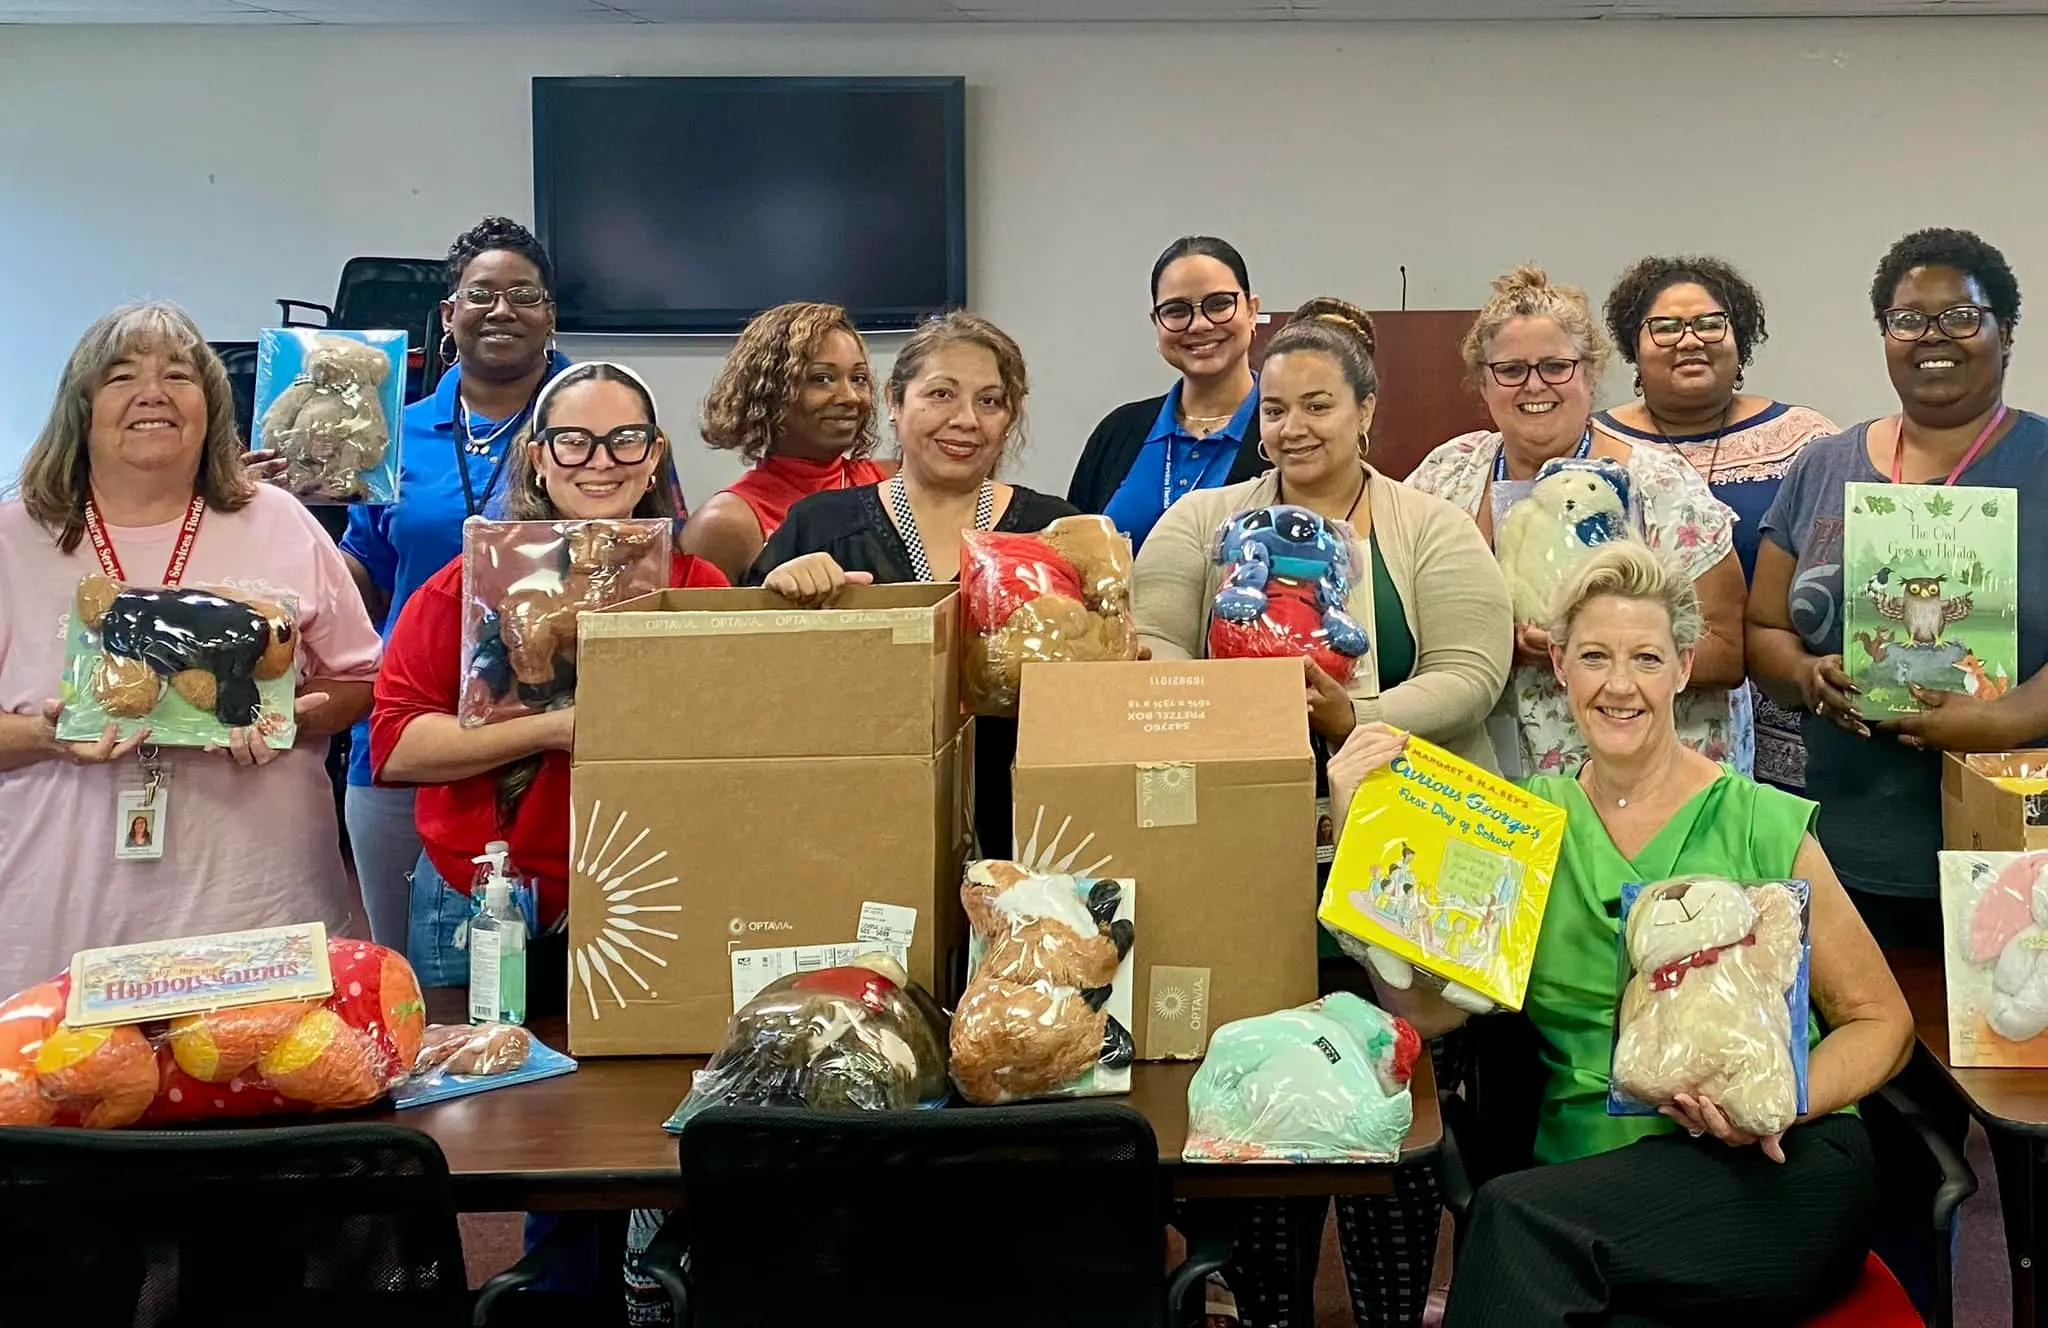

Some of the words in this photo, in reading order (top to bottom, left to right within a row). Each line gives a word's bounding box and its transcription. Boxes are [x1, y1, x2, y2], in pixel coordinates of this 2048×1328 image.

[1908, 524, 1928, 540] The
[1934, 525, 1956, 540] Owl
[169, 534, 193, 577] Services
[1888, 541, 1914, 559] Goes
[1937, 543, 1977, 560] Holiday
[711, 616, 762, 628] OPTAVIA
[1127, 712, 1153, 720] BOX
[1156, 711, 1205, 720] PRETZEL
[1412, 749, 1464, 777] MARGRET
[1466, 773, 1474, 783] &
[1142, 772, 1153, 805] TAVIA
[1390, 757, 1462, 802] Curious
[1466, 791, 1541, 840] George's
[1399, 787, 1428, 810] First
[1431, 801, 1456, 826] Day
[1459, 820, 1470, 834] of
[1474, 823, 1517, 850] School
[748, 921, 790, 931] OPTAVIA
[1190, 978, 1203, 1031] OPTAVIA
